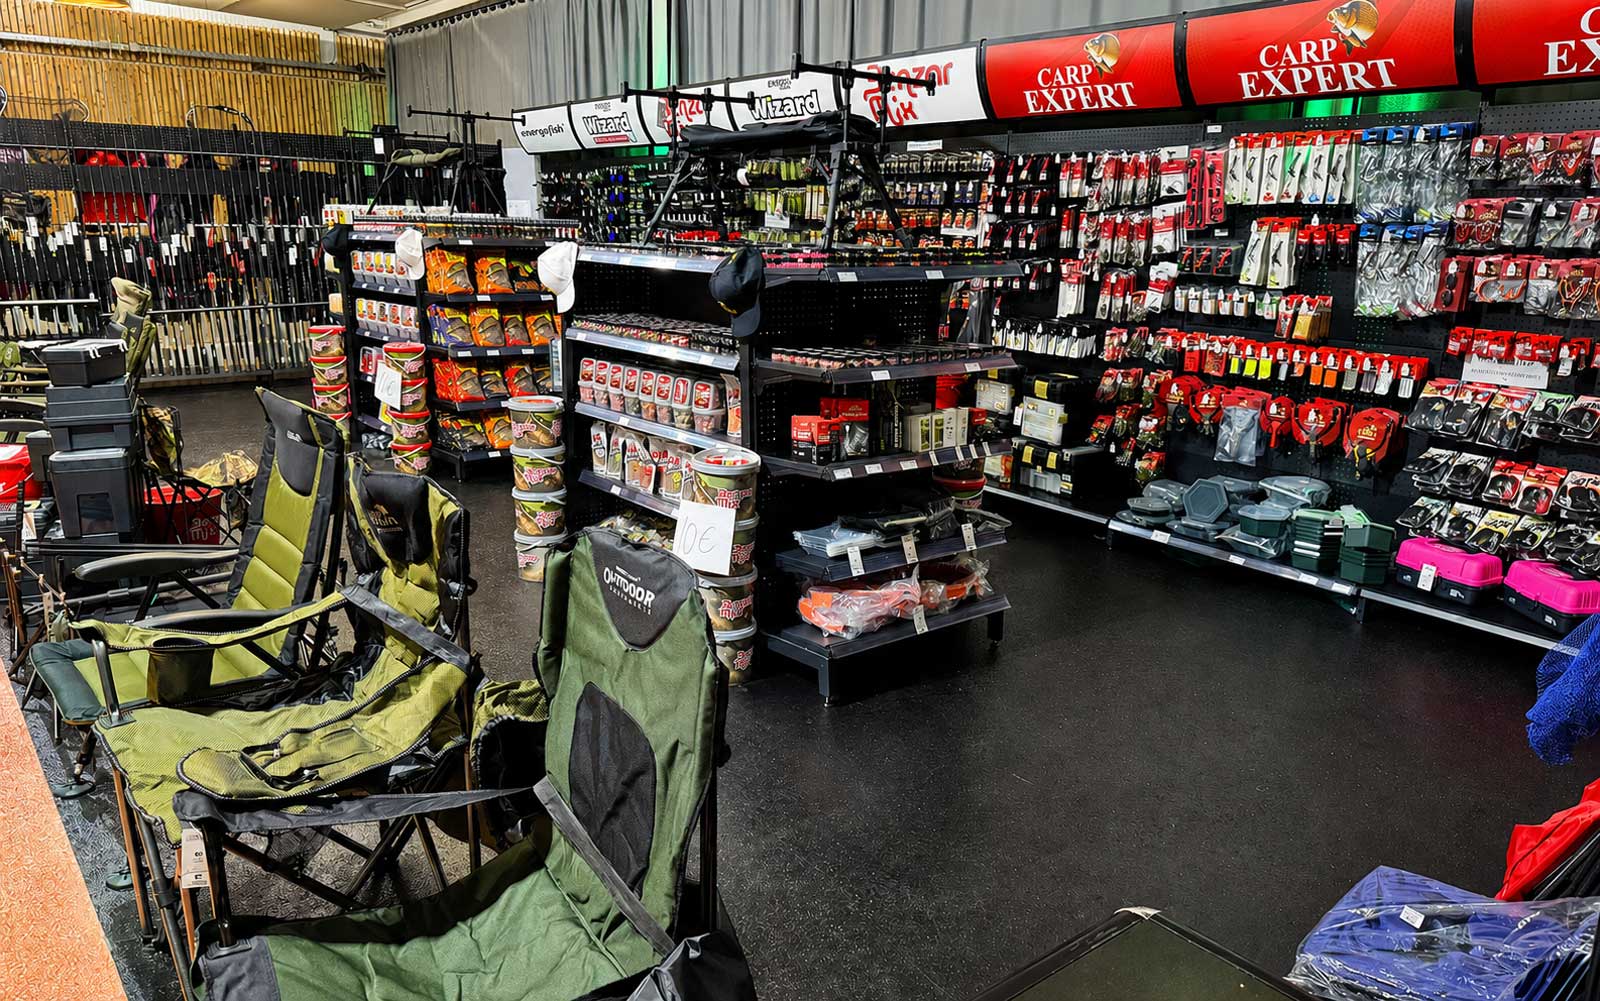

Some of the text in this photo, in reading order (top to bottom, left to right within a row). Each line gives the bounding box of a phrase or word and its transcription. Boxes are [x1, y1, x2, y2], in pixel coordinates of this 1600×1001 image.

[1259, 38, 1337, 68] CARP
[1037, 64, 1093, 88] CARP
[1238, 58, 1397, 99] EXPERT
[751, 89, 821, 121] Wizard
[1023, 82, 1137, 114] EXPERT
[521, 124, 564, 138] energofish
[582, 112, 632, 136] Wizard
[603, 566, 656, 609] OUTDOOR
